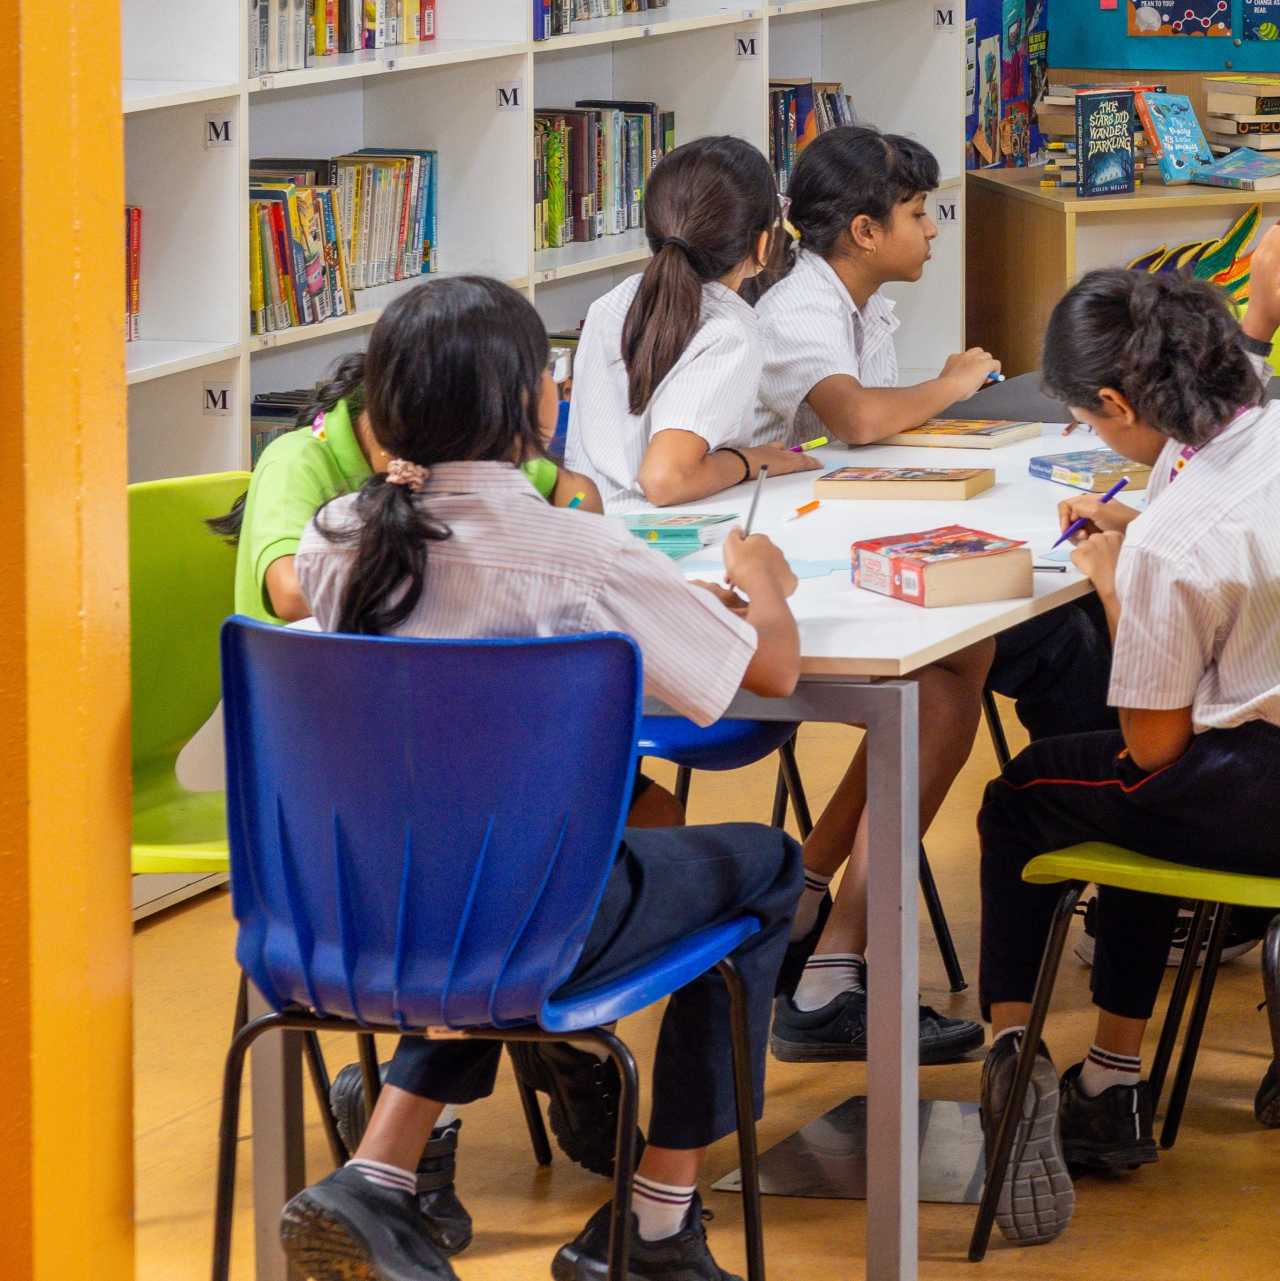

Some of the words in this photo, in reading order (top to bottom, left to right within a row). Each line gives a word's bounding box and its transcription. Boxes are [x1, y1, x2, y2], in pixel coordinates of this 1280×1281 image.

[936, 10, 953, 25] M
[737, 39, 755, 55] M
[498, 88, 518, 106] M
[1099, 102, 1118, 112] THE
[1090, 111, 1113, 125] STARS
[1114, 115, 1129, 124] DID
[207, 121, 230, 141] M
[1090, 124, 1127, 140] WANDER
[1089, 137, 1132, 160] DARKLING
[939, 205, 955, 219] M
[206, 390, 228, 409] M
